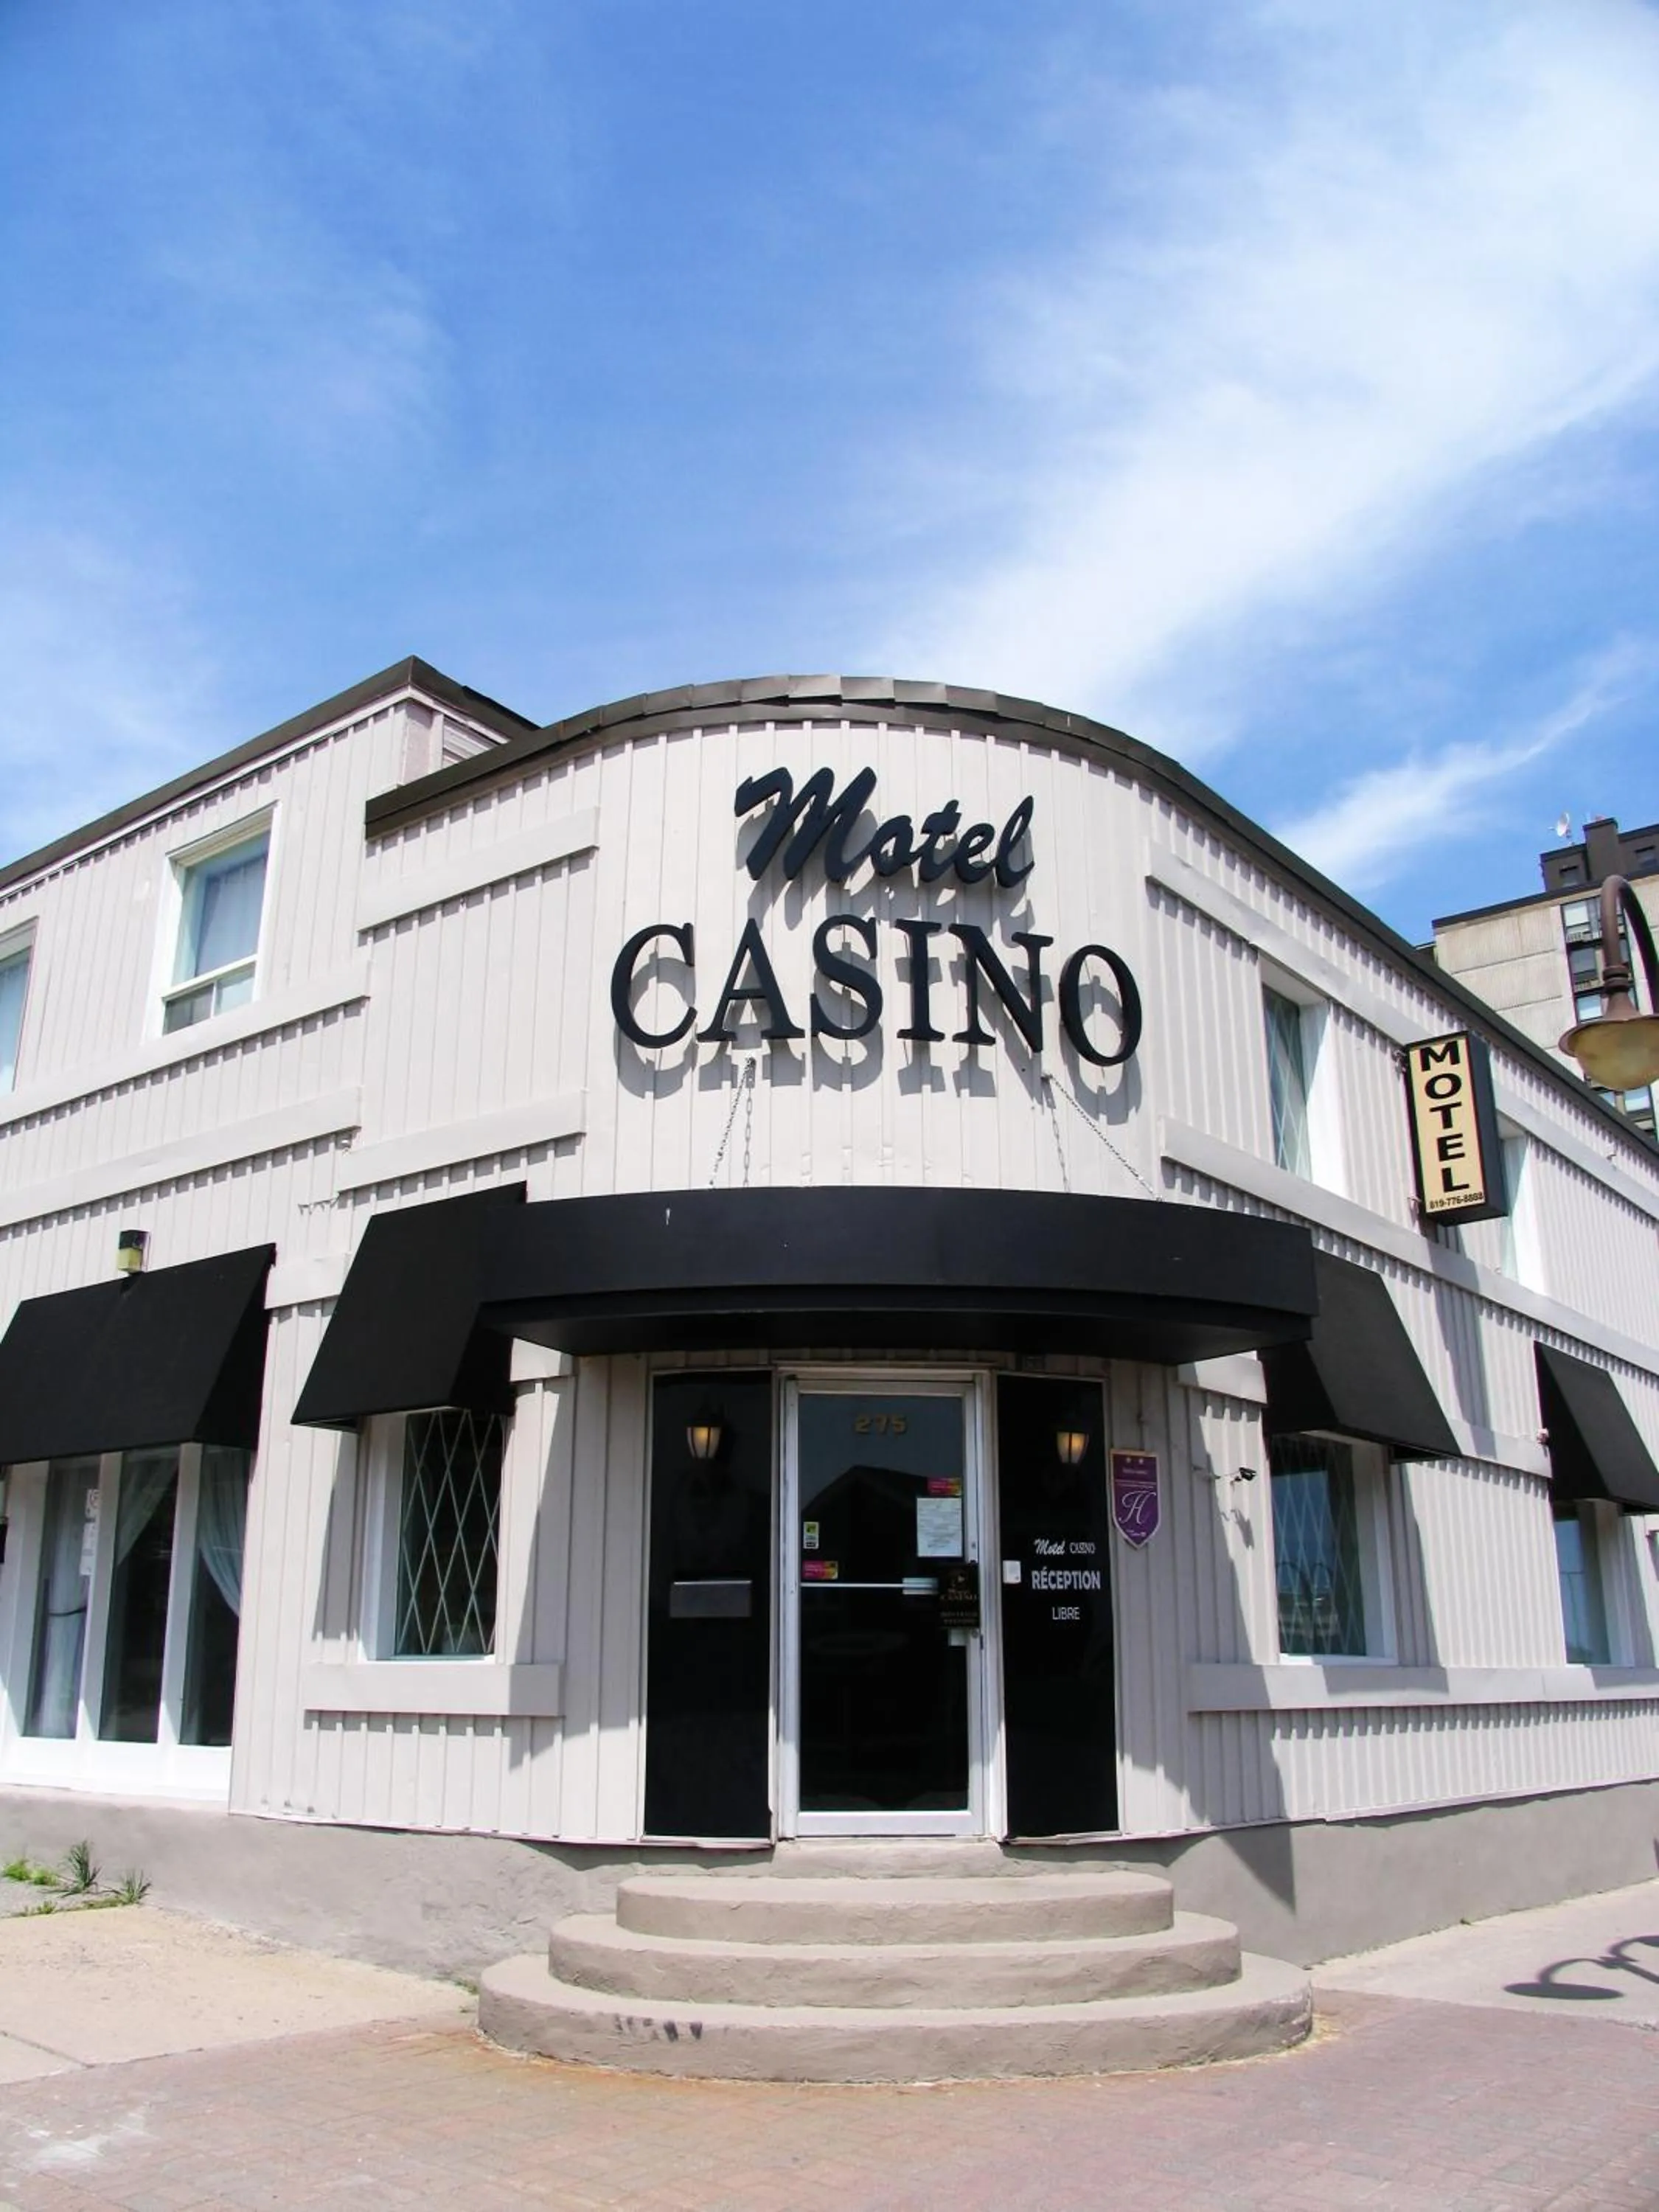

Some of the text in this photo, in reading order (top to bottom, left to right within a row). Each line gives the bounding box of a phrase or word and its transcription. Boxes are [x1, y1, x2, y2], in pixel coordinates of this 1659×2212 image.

[734, 767, 1034, 888] Motel
[611, 914, 1141, 1066] CASINO
[1419, 1040, 1470, 1193] MOTEL
[854, 1413, 908, 1433] 275
[1032, 1566, 1101, 1590] RÉCEPTION
[1052, 1607, 1080, 1620] LIBRE
